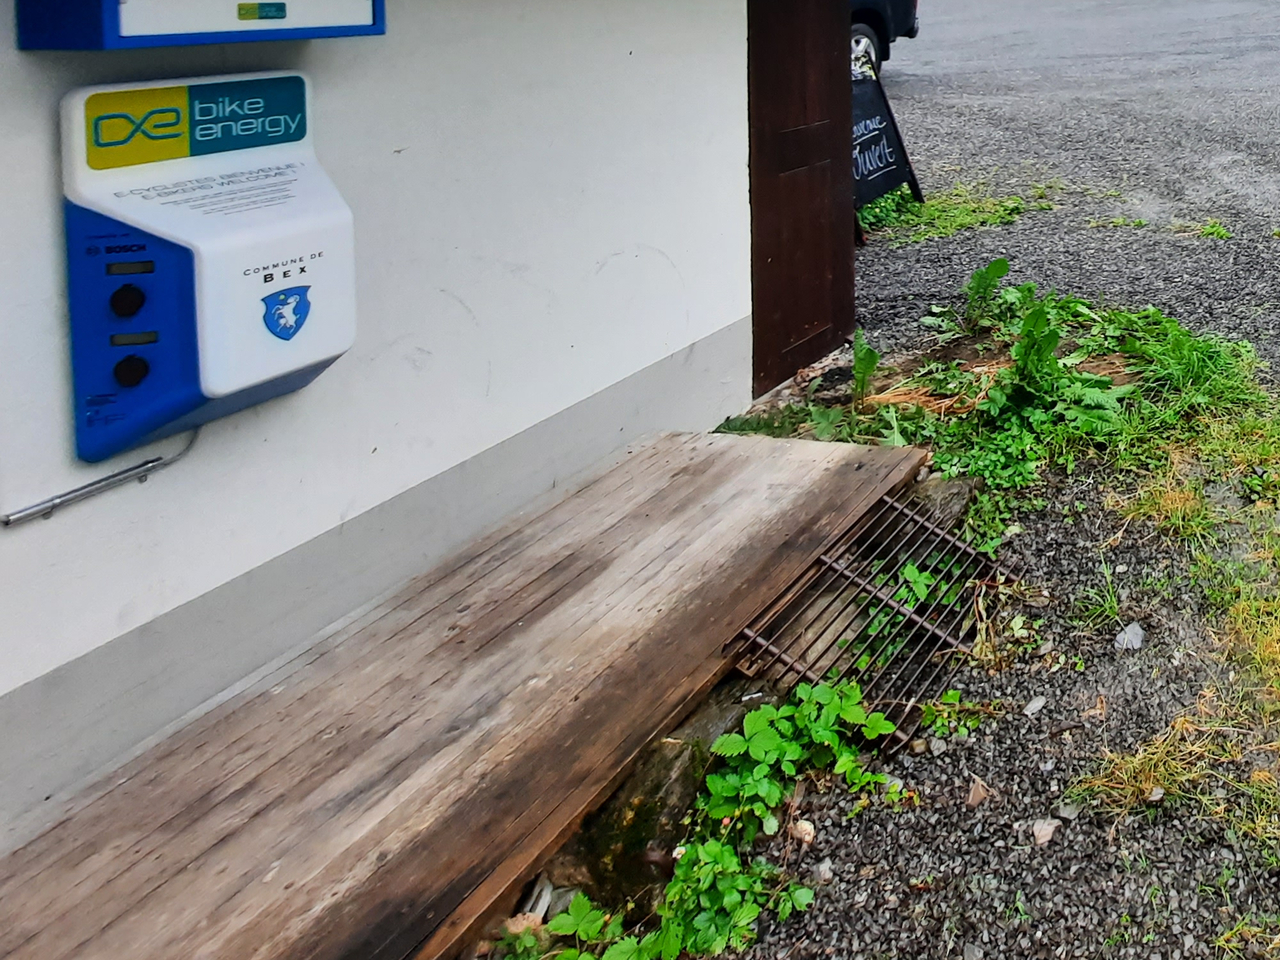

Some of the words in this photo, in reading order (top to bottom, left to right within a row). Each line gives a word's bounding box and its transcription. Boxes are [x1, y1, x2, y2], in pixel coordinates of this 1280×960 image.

[194, 96, 264, 121] bike
[194, 113, 302, 141] energy
[217, 170, 289, 188] WELCOME
[105, 244, 147, 254] BOSCH
[243, 255, 305, 276] COMMUNE
[310, 251, 324, 260] DE
[263, 266, 307, 284] BEX
